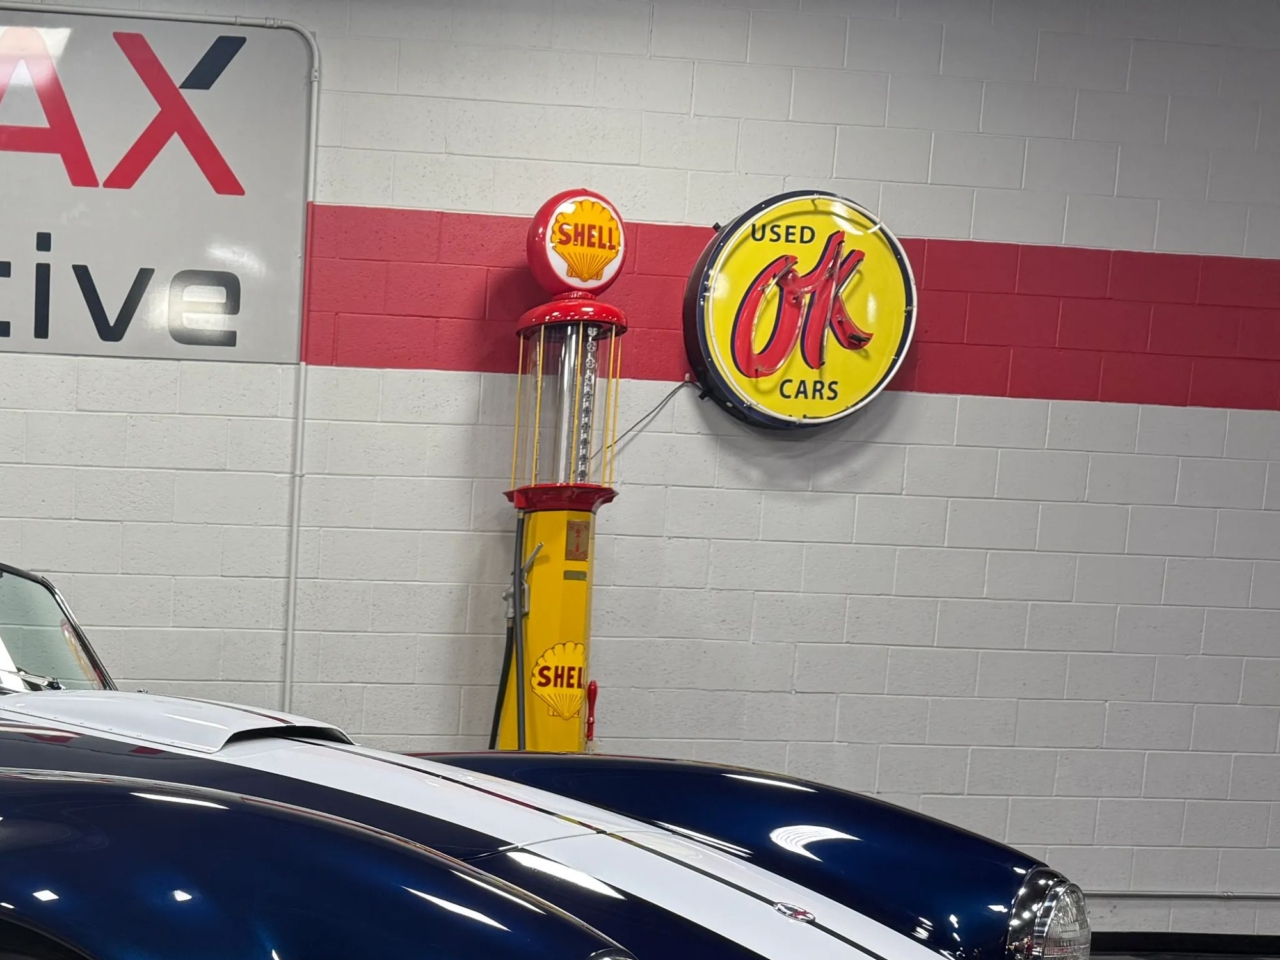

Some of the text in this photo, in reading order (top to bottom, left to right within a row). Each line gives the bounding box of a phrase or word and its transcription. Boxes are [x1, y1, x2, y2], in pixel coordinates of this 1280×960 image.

[558, 223, 616, 251] SHELL
[751, 223, 816, 245] USED
[730, 230, 874, 379] OK
[779, 379, 839, 401] CARS
